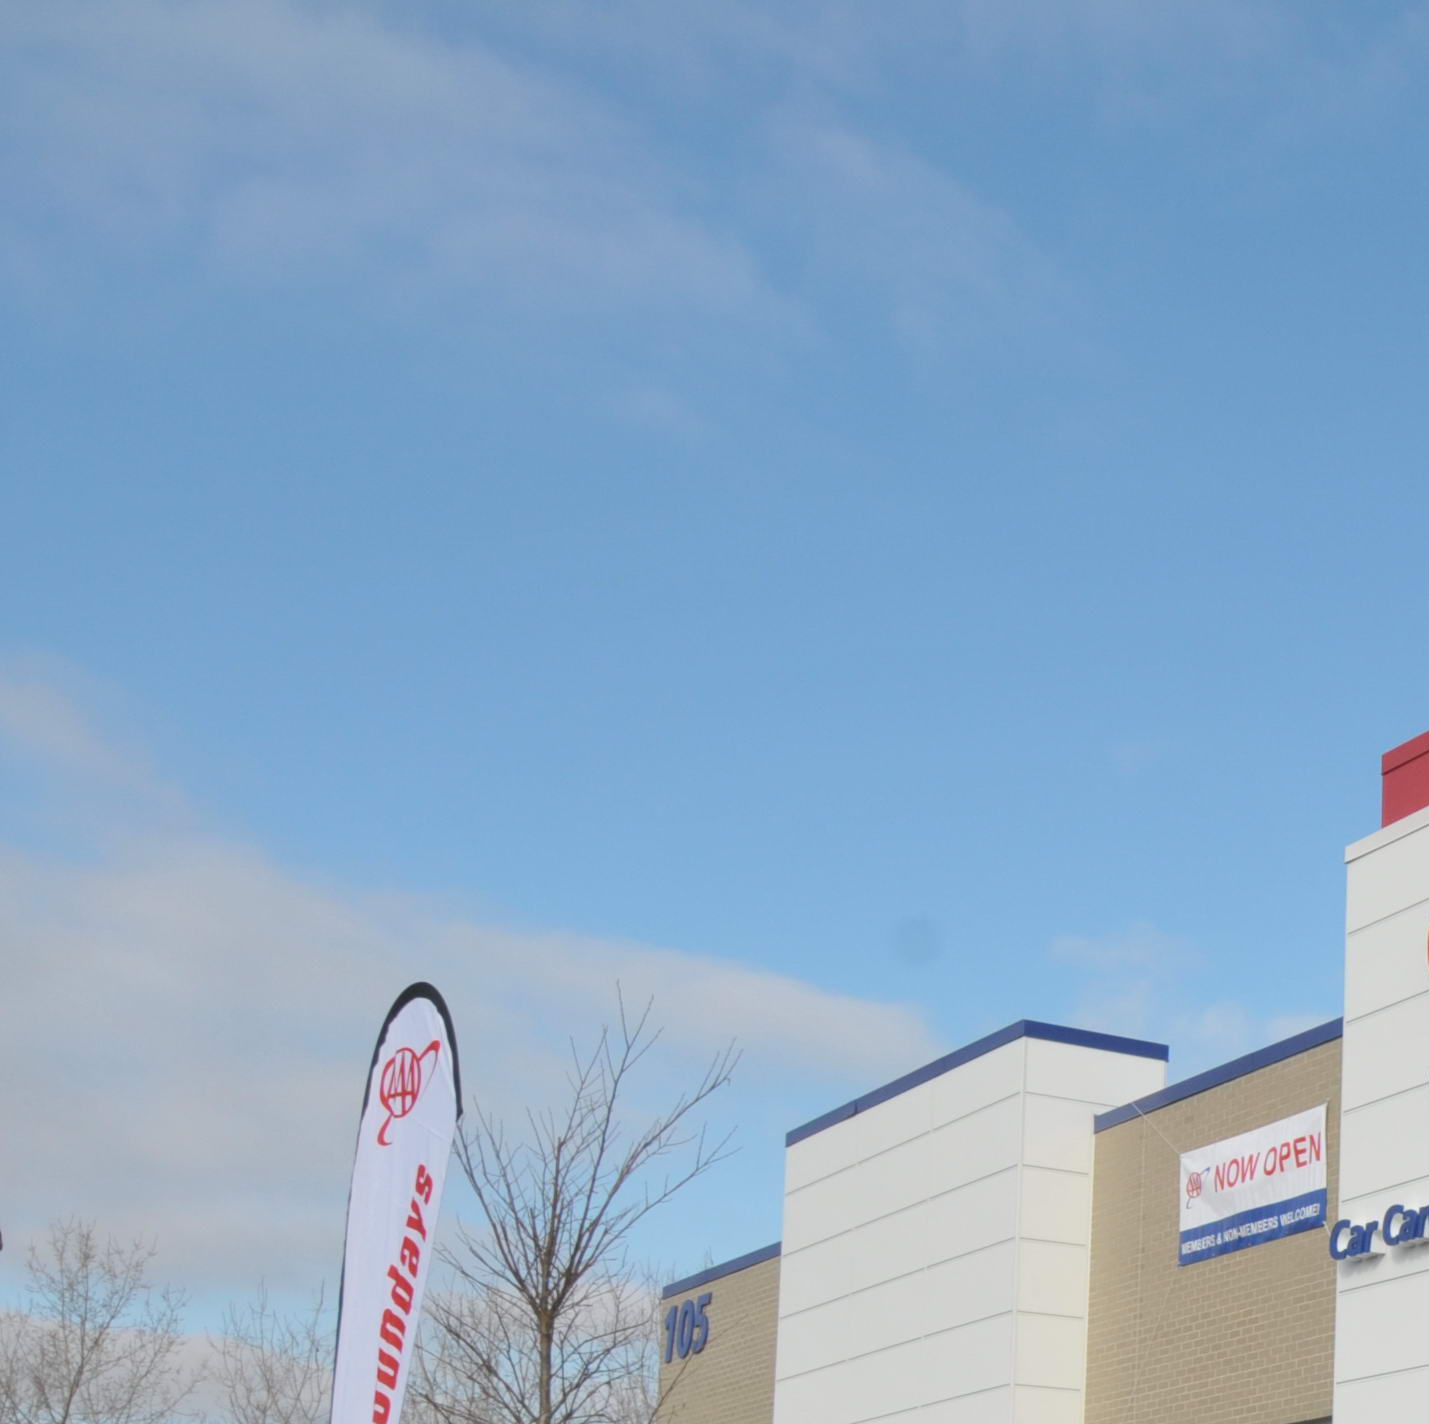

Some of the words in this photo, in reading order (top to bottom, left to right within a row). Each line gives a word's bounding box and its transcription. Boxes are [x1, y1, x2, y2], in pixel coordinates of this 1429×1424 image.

[1213, 1152, 1260, 1193] NOW
[1263, 1132, 1321, 1176] OPEN
[1181, 1234, 1216, 1255] MEMBERS
[1216, 1232, 1222, 1245] &
[1223, 1216, 1279, 1242] NON-MEMBERS
[1280, 1203, 1320, 1226] WELCOME!
[1329, 1218, 1379, 1261] Car
[665, 1292, 713, 1364] 105
